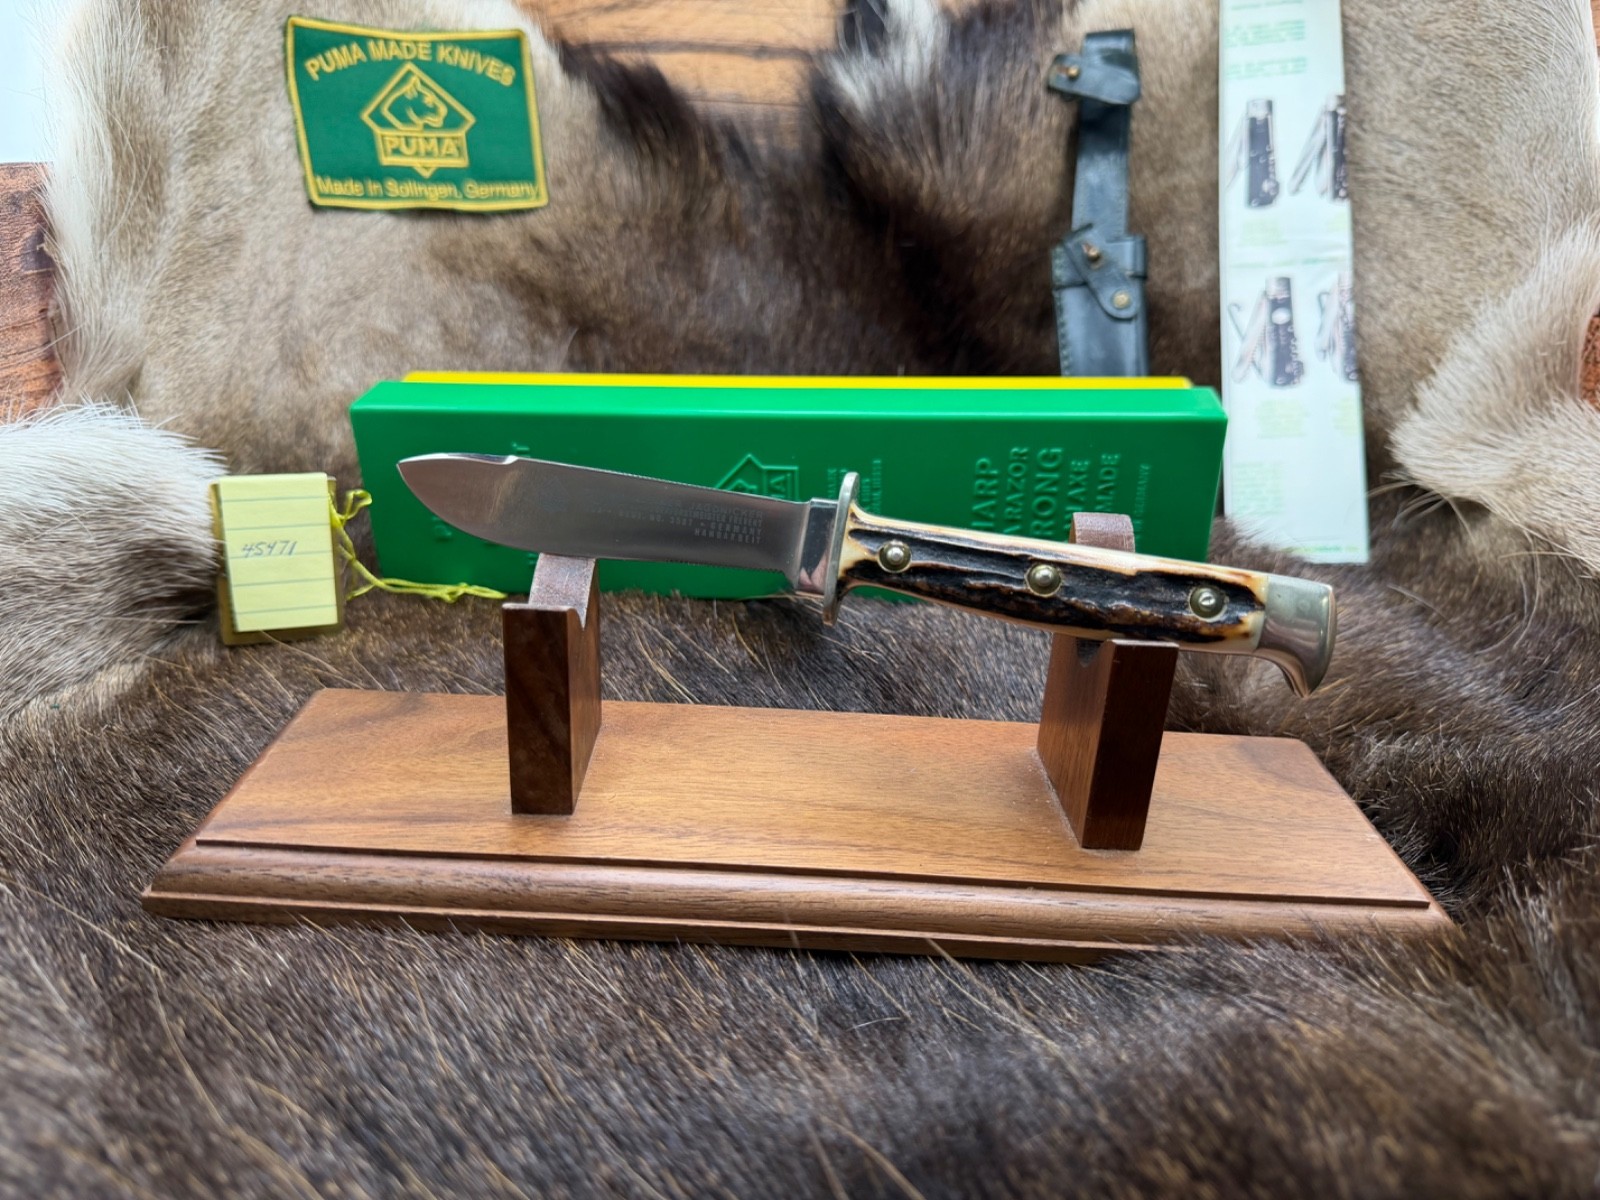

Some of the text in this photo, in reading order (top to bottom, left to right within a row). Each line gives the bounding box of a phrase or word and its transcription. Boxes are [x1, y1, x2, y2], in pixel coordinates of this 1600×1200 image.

[305, 40, 516, 86] PUMA MADE KNIVES
[384, 136, 460, 157] PUMA
[316, 177, 365, 197] Made
[385, 179, 462, 201] Solingen,
[464, 181, 538, 200] Germany
[1004, 447, 1028, 520] RAZOR
[1031, 448, 1064, 536] RONG
[1068, 460, 1090, 502] AXE
